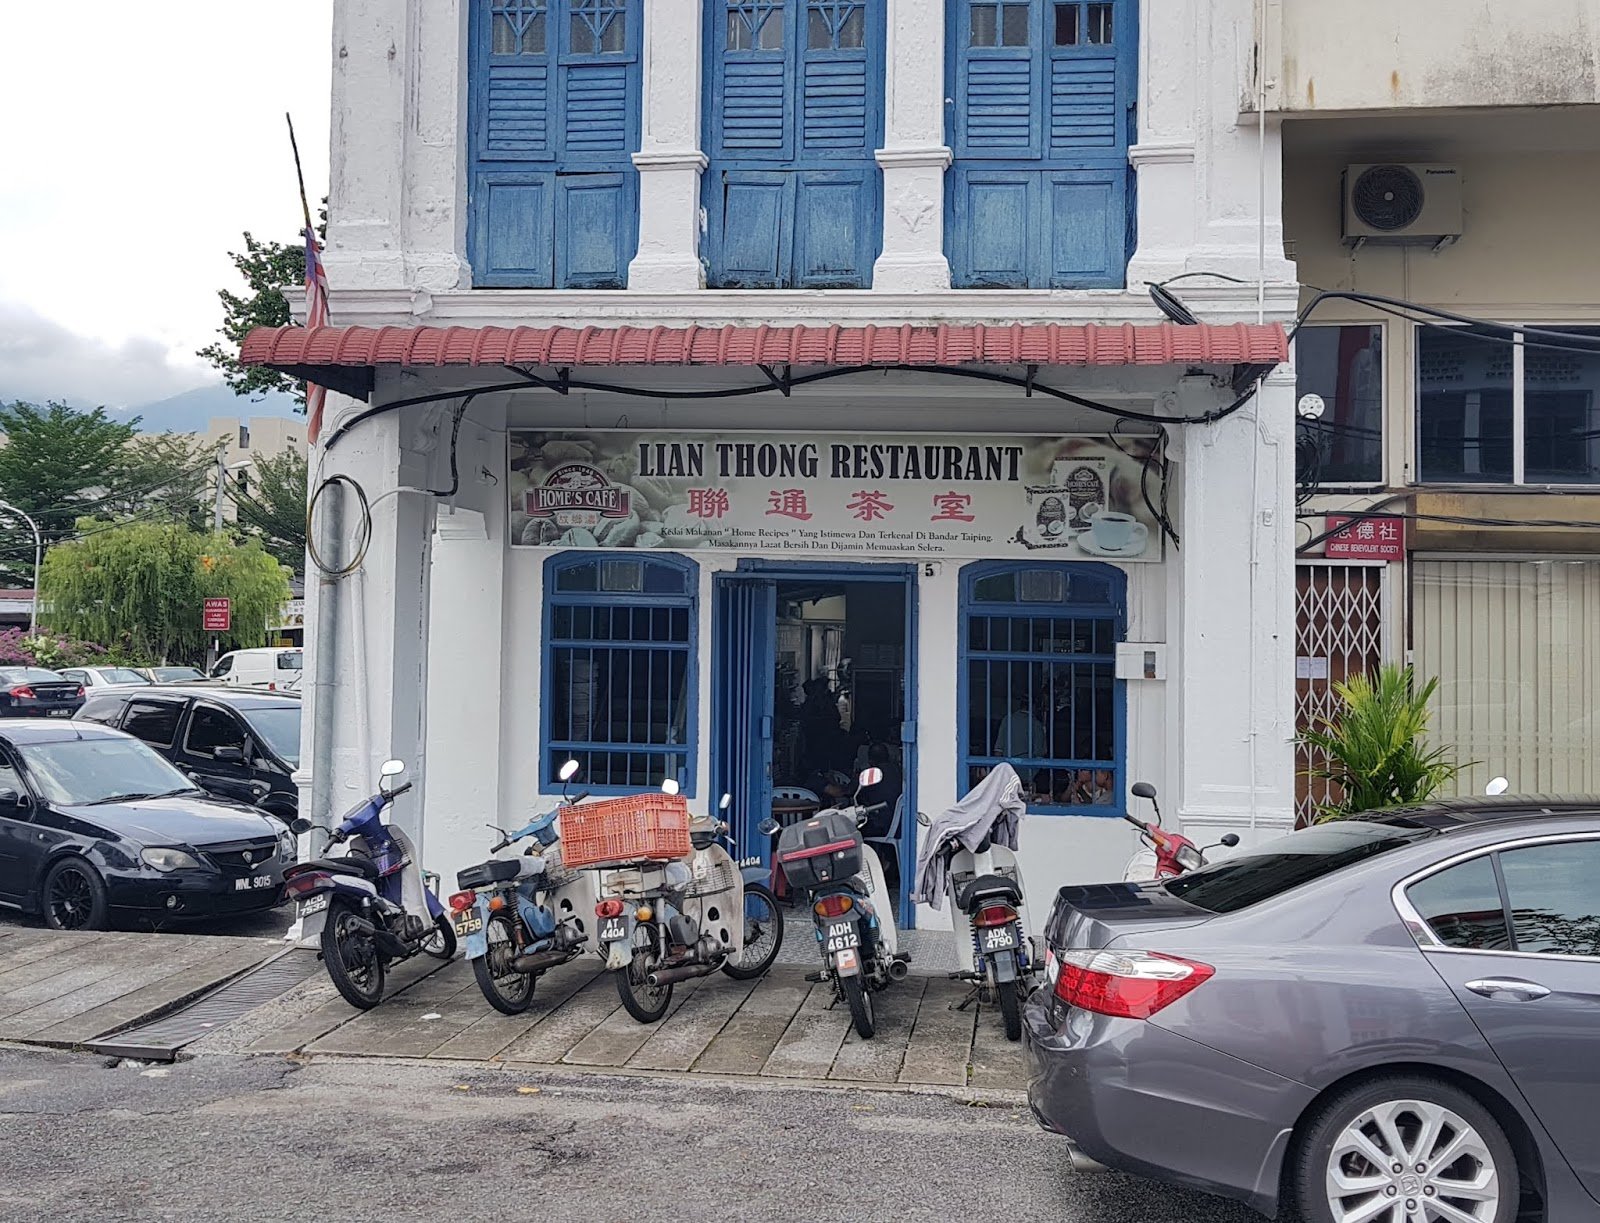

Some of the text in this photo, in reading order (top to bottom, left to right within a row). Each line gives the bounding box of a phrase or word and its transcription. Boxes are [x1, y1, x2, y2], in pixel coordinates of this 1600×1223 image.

[639, 443, 1023, 481] LIAN THONG RESTAURANT
[539, 489, 583, 507] HOME'S
[686, 488, 976, 522] 聯通茶室
[661, 527, 683, 536] Kedai
[686, 528, 722, 536] Makanan
[799, 529, 818, 538] Yang
[820, 530, 857, 539] Istimewa
[859, 531, 876, 539] Dan
[878, 531, 914, 540] Terkenal
[916, 531, 926, 540] Di
[929, 531, 958, 540] Bandar
[961, 532, 993, 542] Taiping.
[708, 539, 758, 548] Masakannya
[760, 540, 781, 548] Lazat
[784, 540, 809, 549] Bersih
[812, 541, 828, 550] Dan
[831, 542, 863, 551] Dijamin
[866, 542, 915, 551] Memuaskan
[1330, 543, 1399, 554] CHINESE BENEVOLENT SOCIETY
[925, 563, 934, 576] 5
[740, 856, 760, 867] 4404
[235, 875, 271, 890] WNL 9015
[462, 908, 472, 921] AT
[456, 918, 482, 935] 5758
[606, 918, 618, 928] AT
[829, 921, 852, 937] ADH
[601, 927, 625, 938] 4404
[988, 927, 1007, 938] ADK
[828, 933, 858, 950] 4612
[986, 936, 1013, 949] 4790
